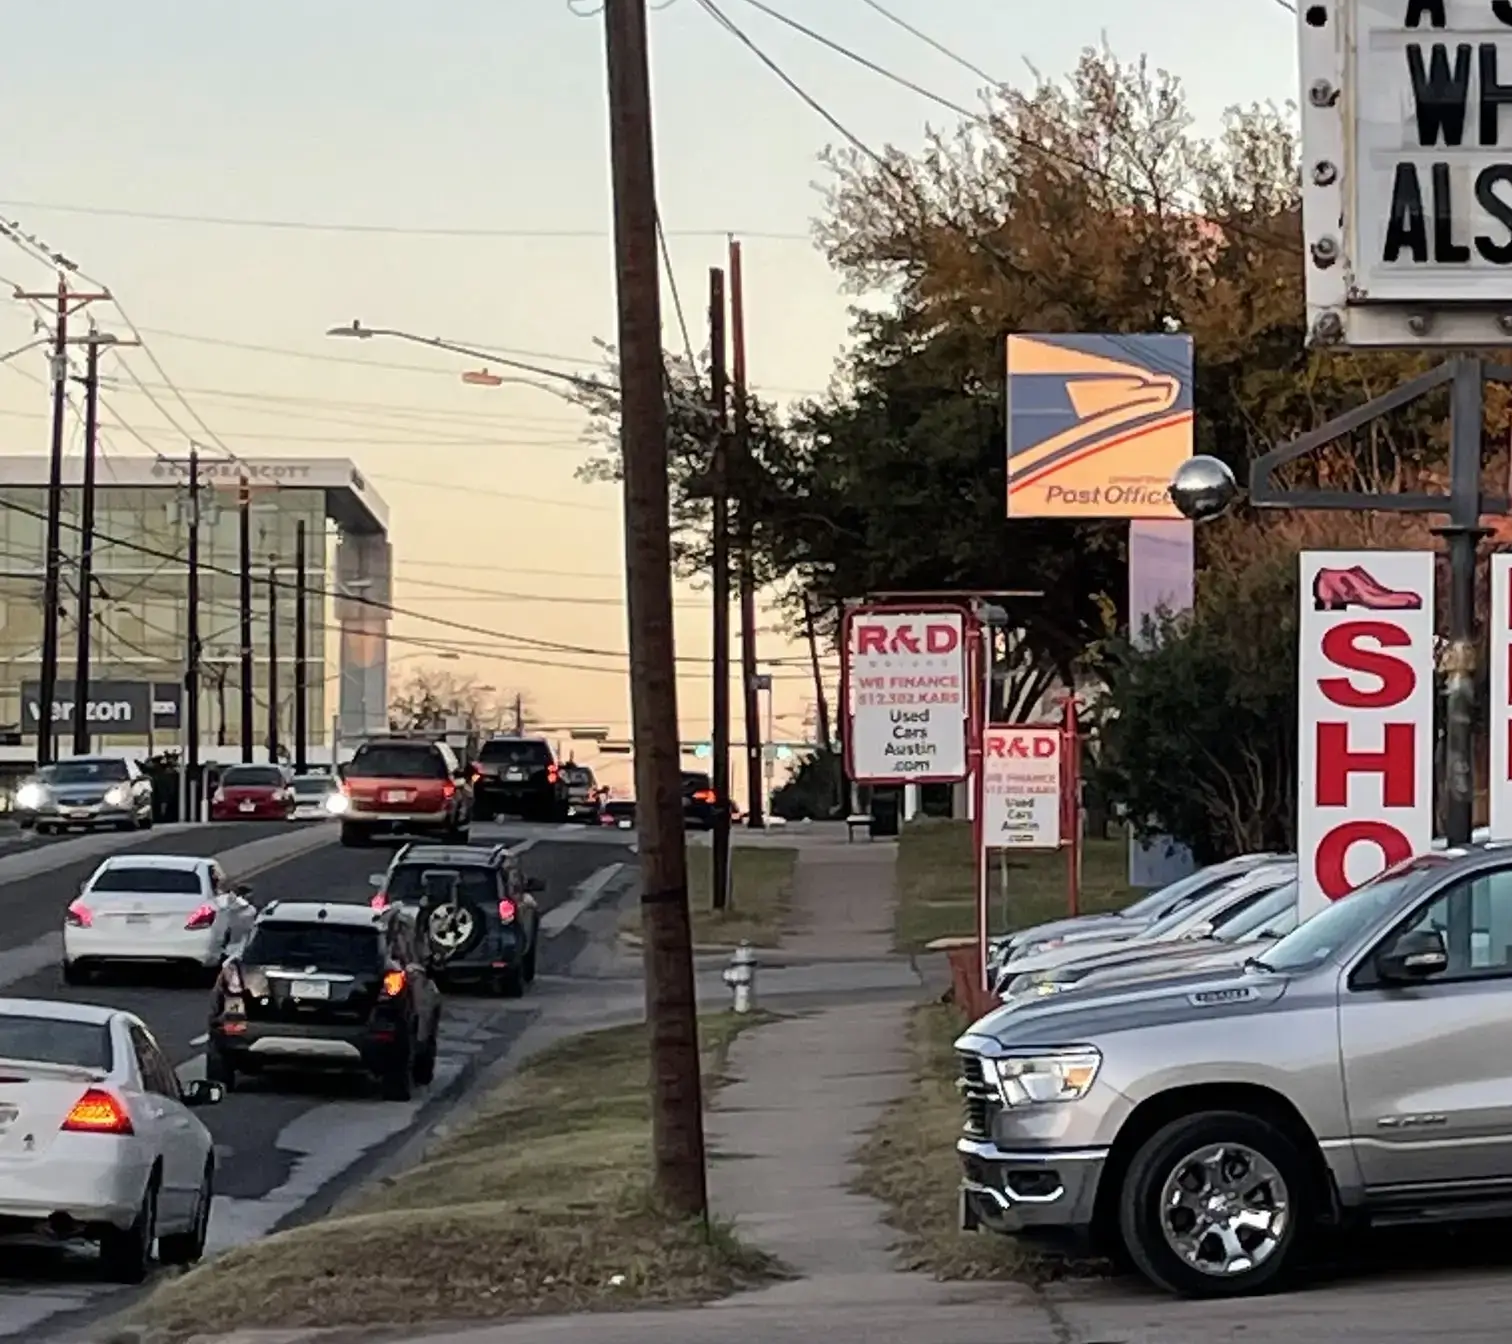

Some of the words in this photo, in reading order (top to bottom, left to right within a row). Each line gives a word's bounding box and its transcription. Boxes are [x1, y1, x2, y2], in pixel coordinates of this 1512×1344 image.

[1045, 485, 1101, 505] Post
[858, 625, 958, 655] R&D
[29, 701, 132, 721] verzon
[889, 709, 931, 723] Used
[892, 725, 928, 739] Cars
[884, 742, 937, 756] Austin
[987, 737, 1057, 758] R&D
[1316, 620, 1416, 902] SHO
